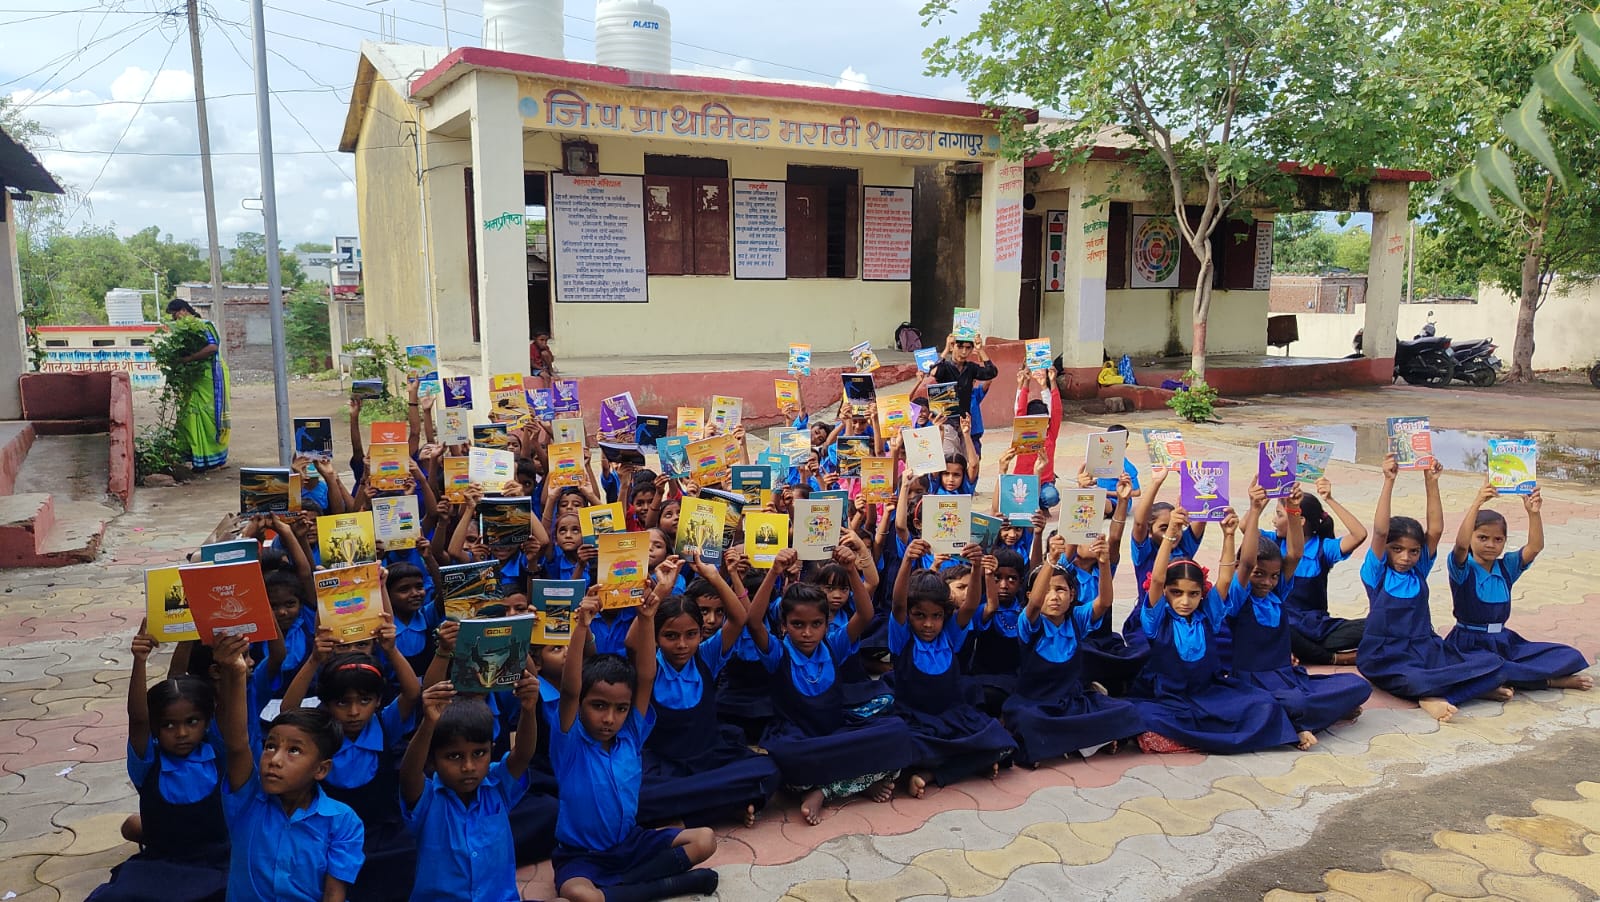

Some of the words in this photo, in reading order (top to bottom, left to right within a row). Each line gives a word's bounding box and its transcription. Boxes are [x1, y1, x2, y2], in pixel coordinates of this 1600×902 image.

[632, 20, 659, 30] PLASTO
[629, 102, 771, 140] प्राथमिक
[779, 115, 861, 147] मराठी
[866, 120, 936, 152] शाळा
[938, 131, 984, 156] नागापुर
[1496, 445, 1531, 454] GOLD
[1188, 467, 1224, 477] GOLD
[446, 573, 465, 581] Aarti
[319, 578, 339, 588] Aarti
[498, 673, 520, 683] Aarti
